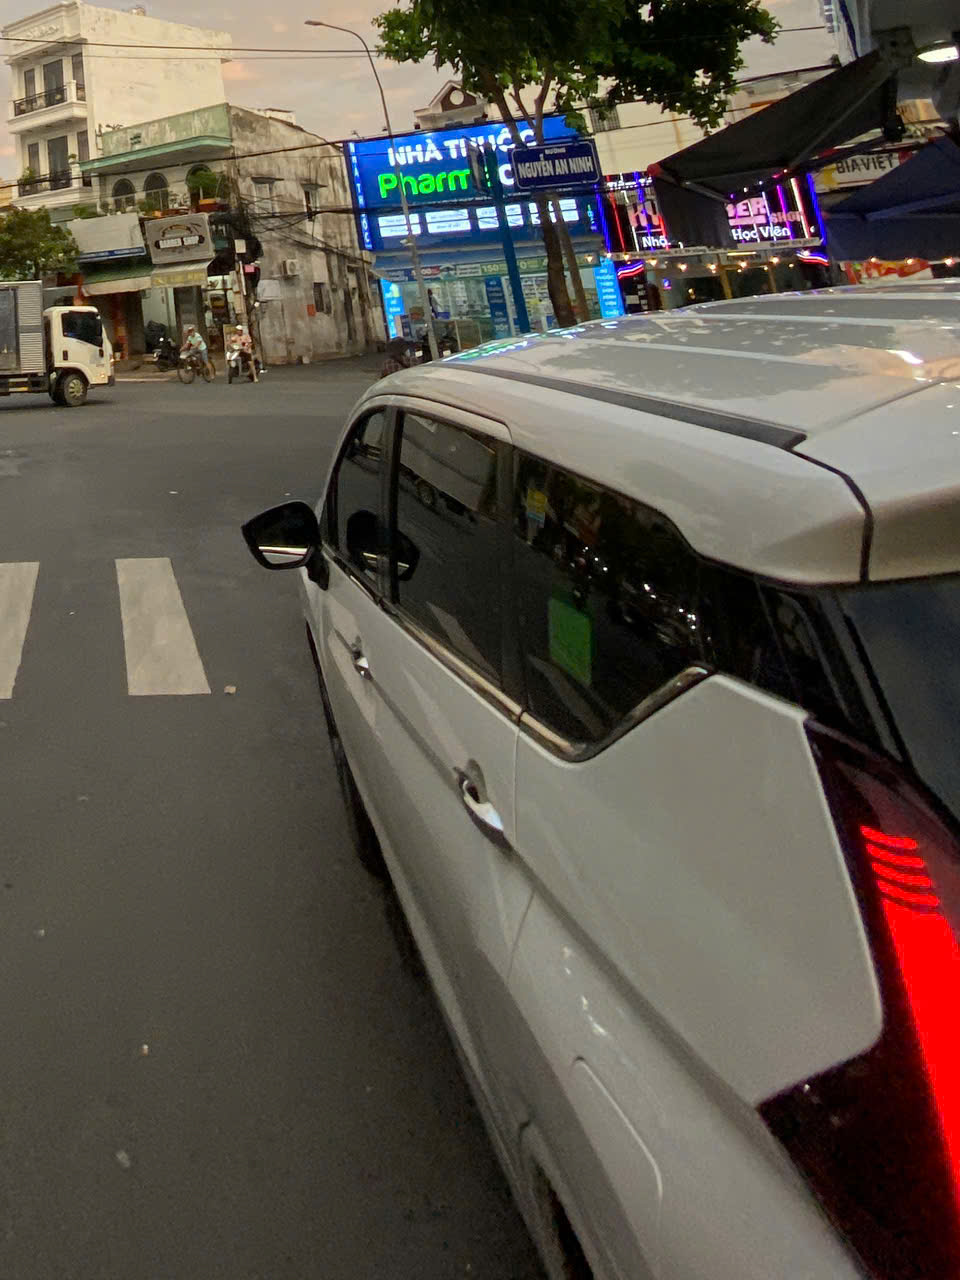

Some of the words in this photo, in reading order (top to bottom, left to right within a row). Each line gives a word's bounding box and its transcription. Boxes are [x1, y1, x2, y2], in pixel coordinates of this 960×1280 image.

[387, 139, 443, 167] NHÀ
[517, 153, 554, 179] NGUYỄN
[554, 158, 568, 176] AN
[568, 156, 594, 174] NINH
[835, 158, 861, 174] BIA
